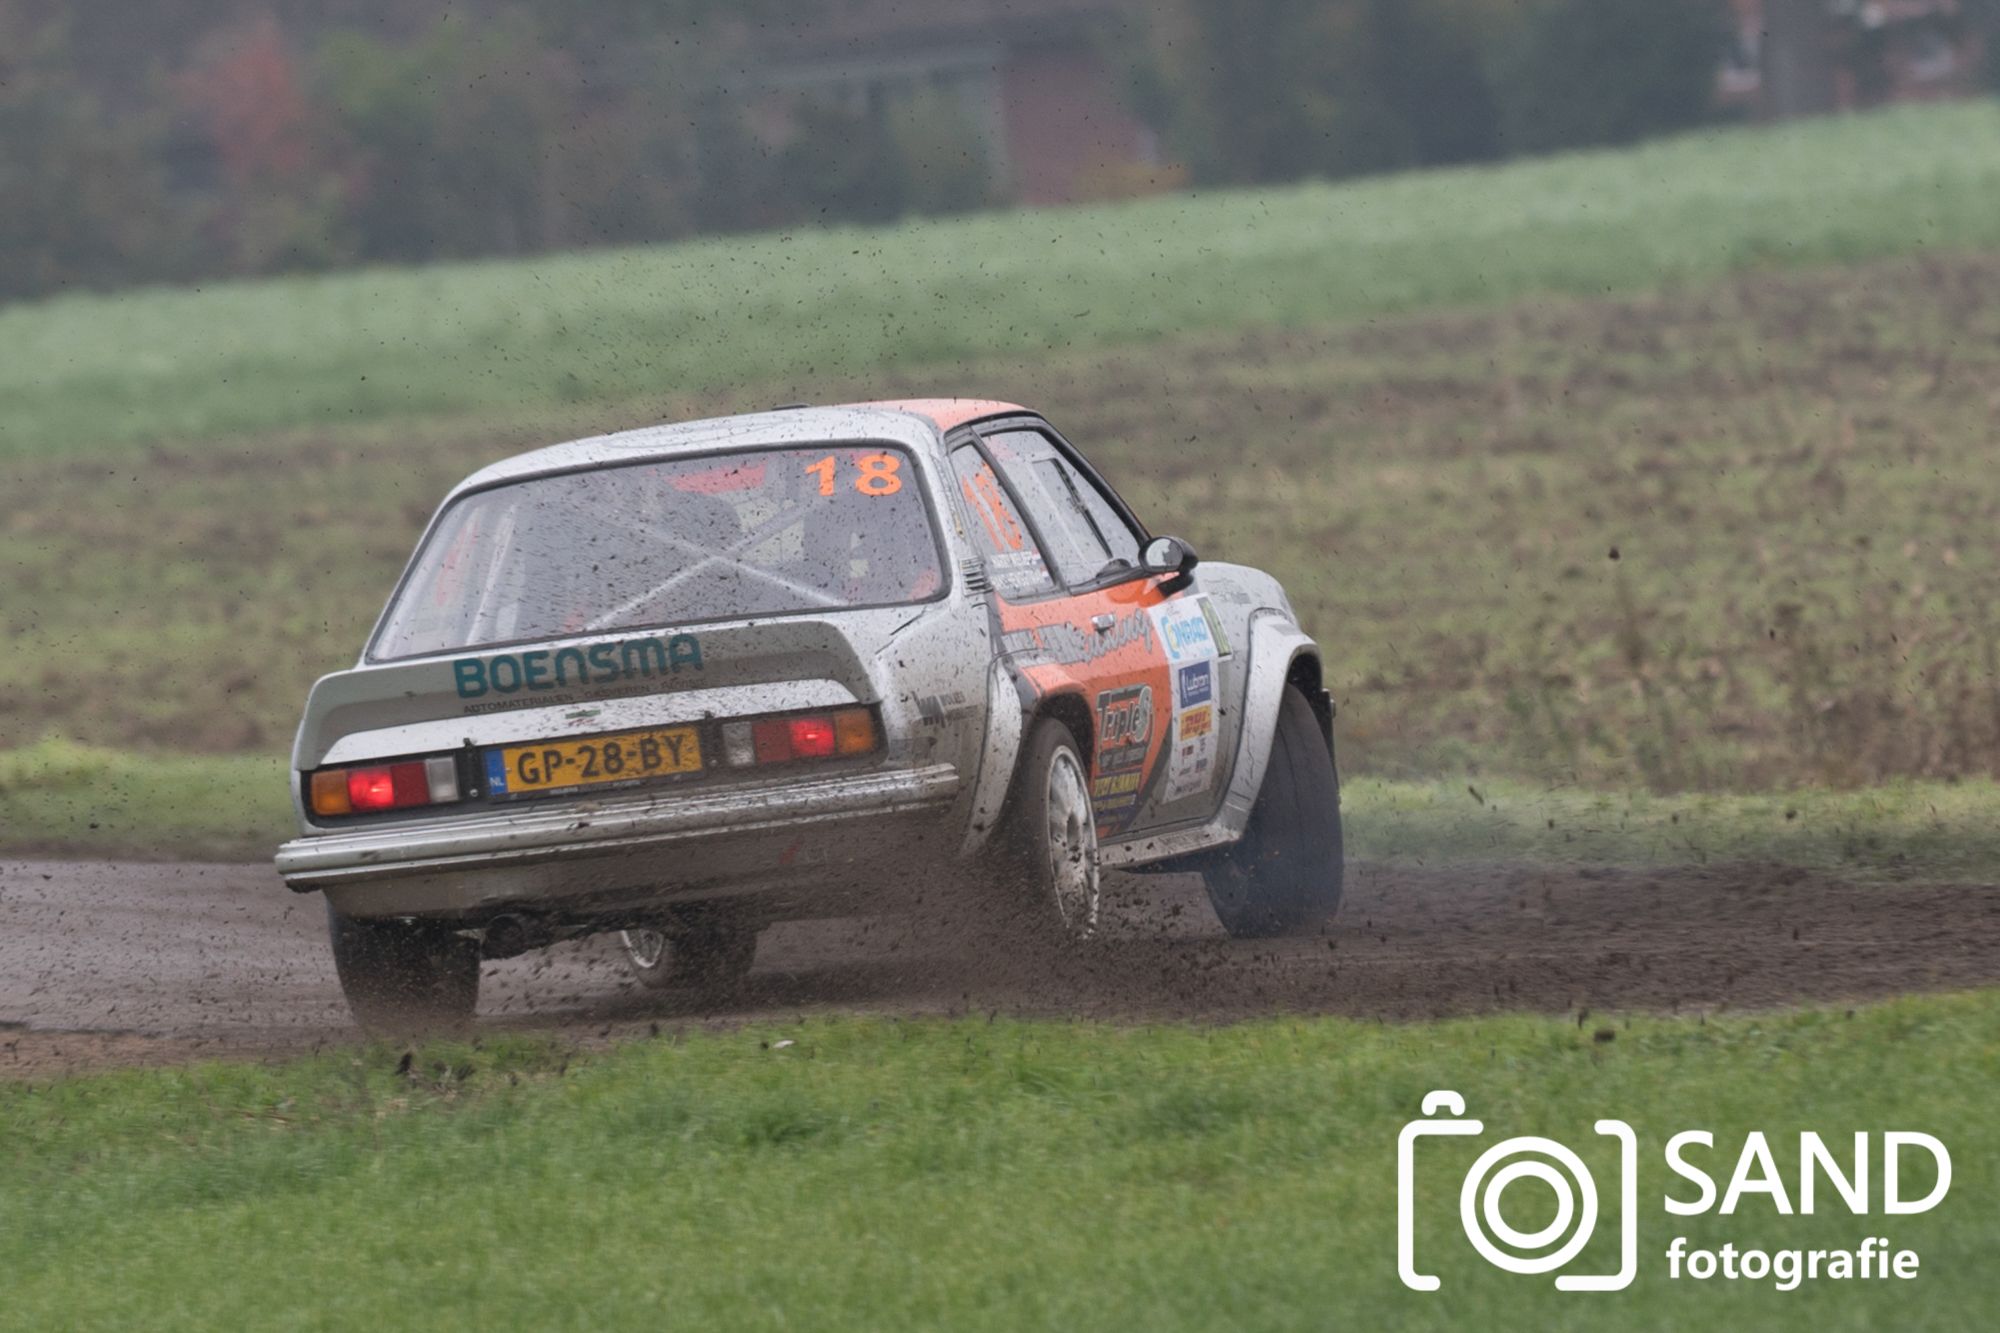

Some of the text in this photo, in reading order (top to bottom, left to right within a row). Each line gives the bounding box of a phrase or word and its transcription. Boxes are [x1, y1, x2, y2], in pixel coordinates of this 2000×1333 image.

[803, 454, 902, 497] 18
[454, 633, 704, 698] BOENSMA
[489, 775, 505, 787] NL
[517, 734, 685, 785] GP-28-BY
